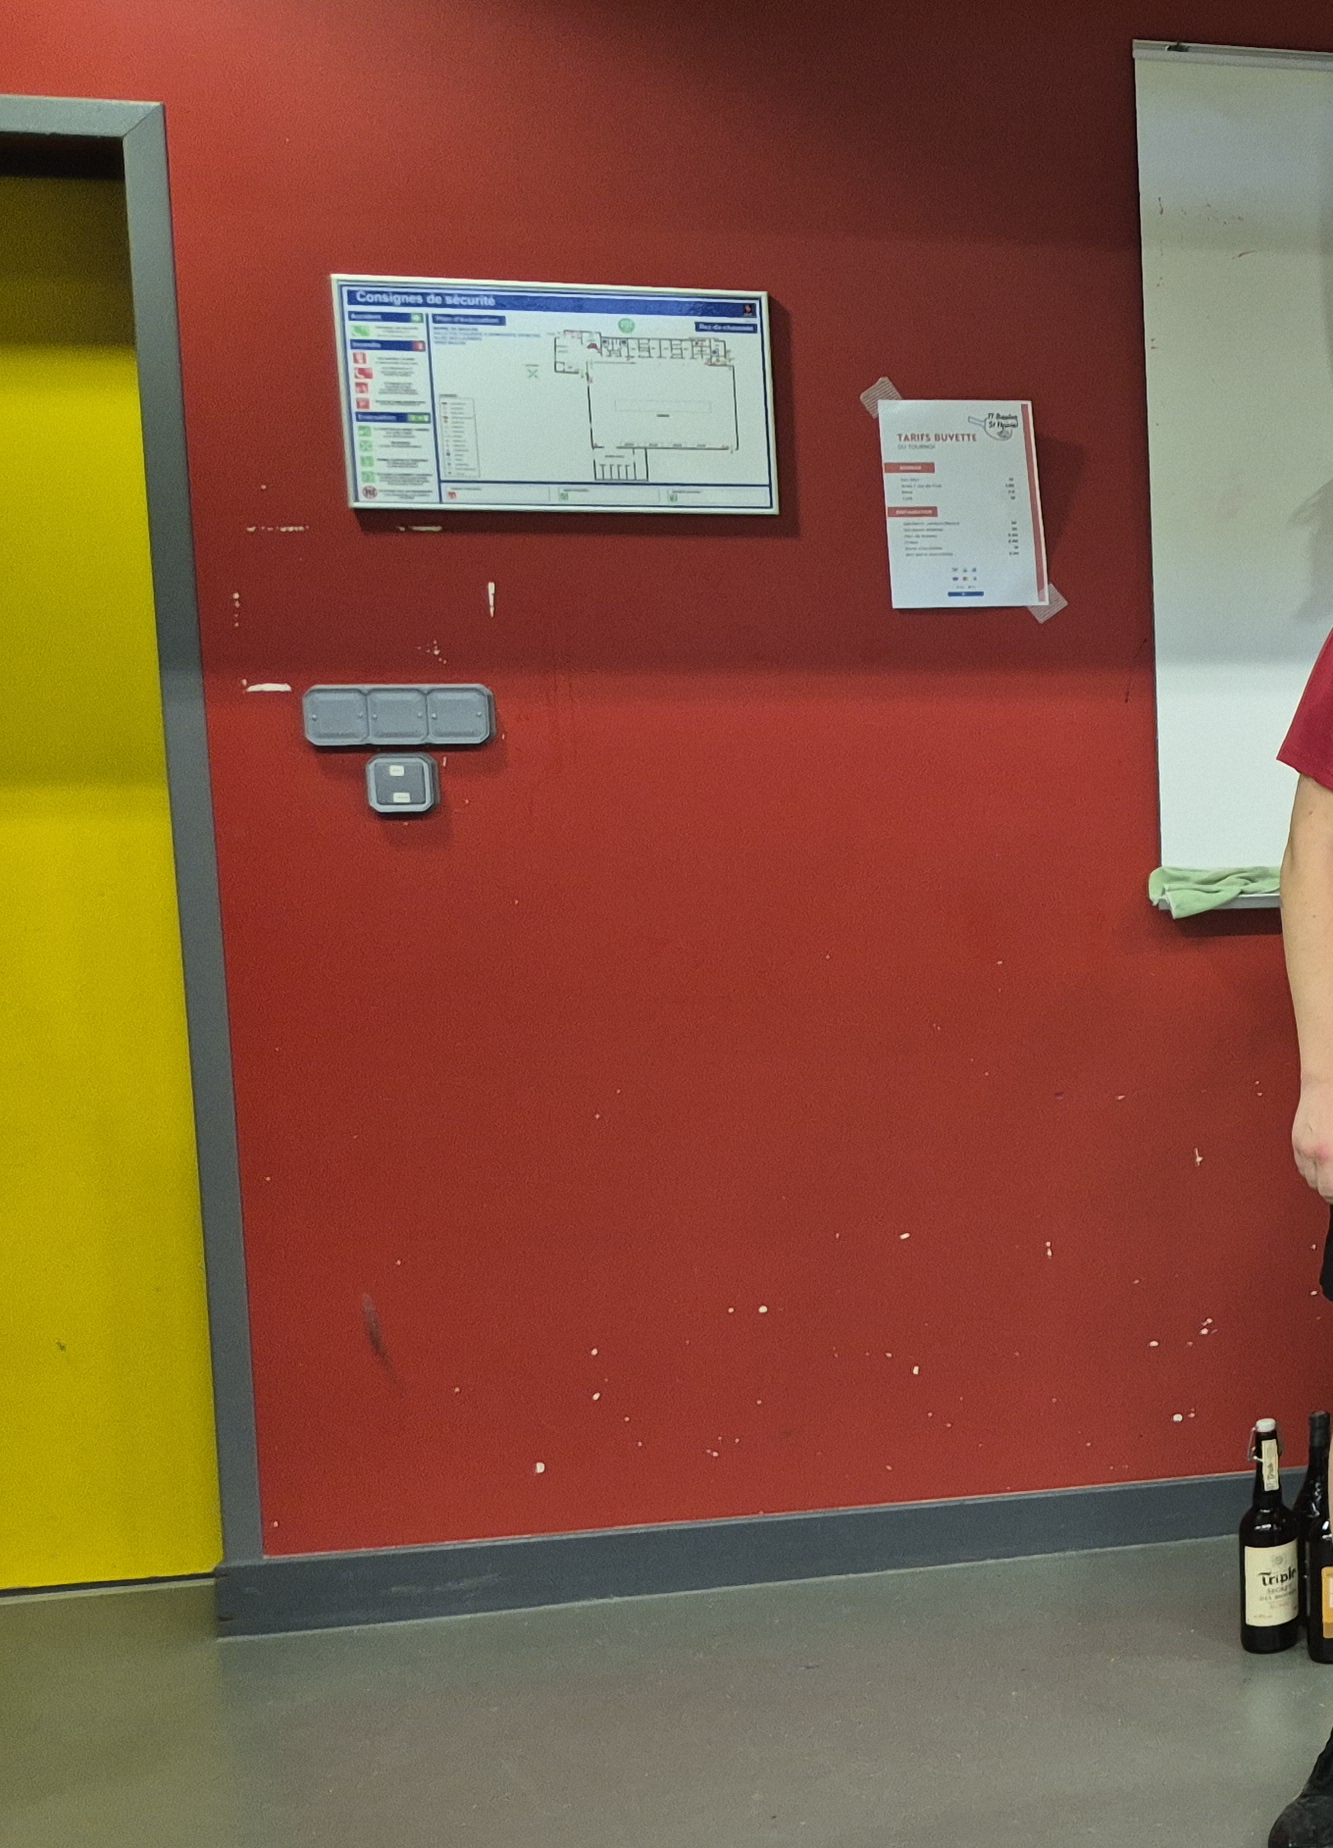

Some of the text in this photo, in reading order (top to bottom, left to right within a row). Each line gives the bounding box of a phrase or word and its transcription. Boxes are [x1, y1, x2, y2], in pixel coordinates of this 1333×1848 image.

[356, 291, 496, 307] Consignes de sécurité
[897, 433, 977, 442] TARIFS BUVETTE
[1258, 1566, 1297, 1587] Triple
